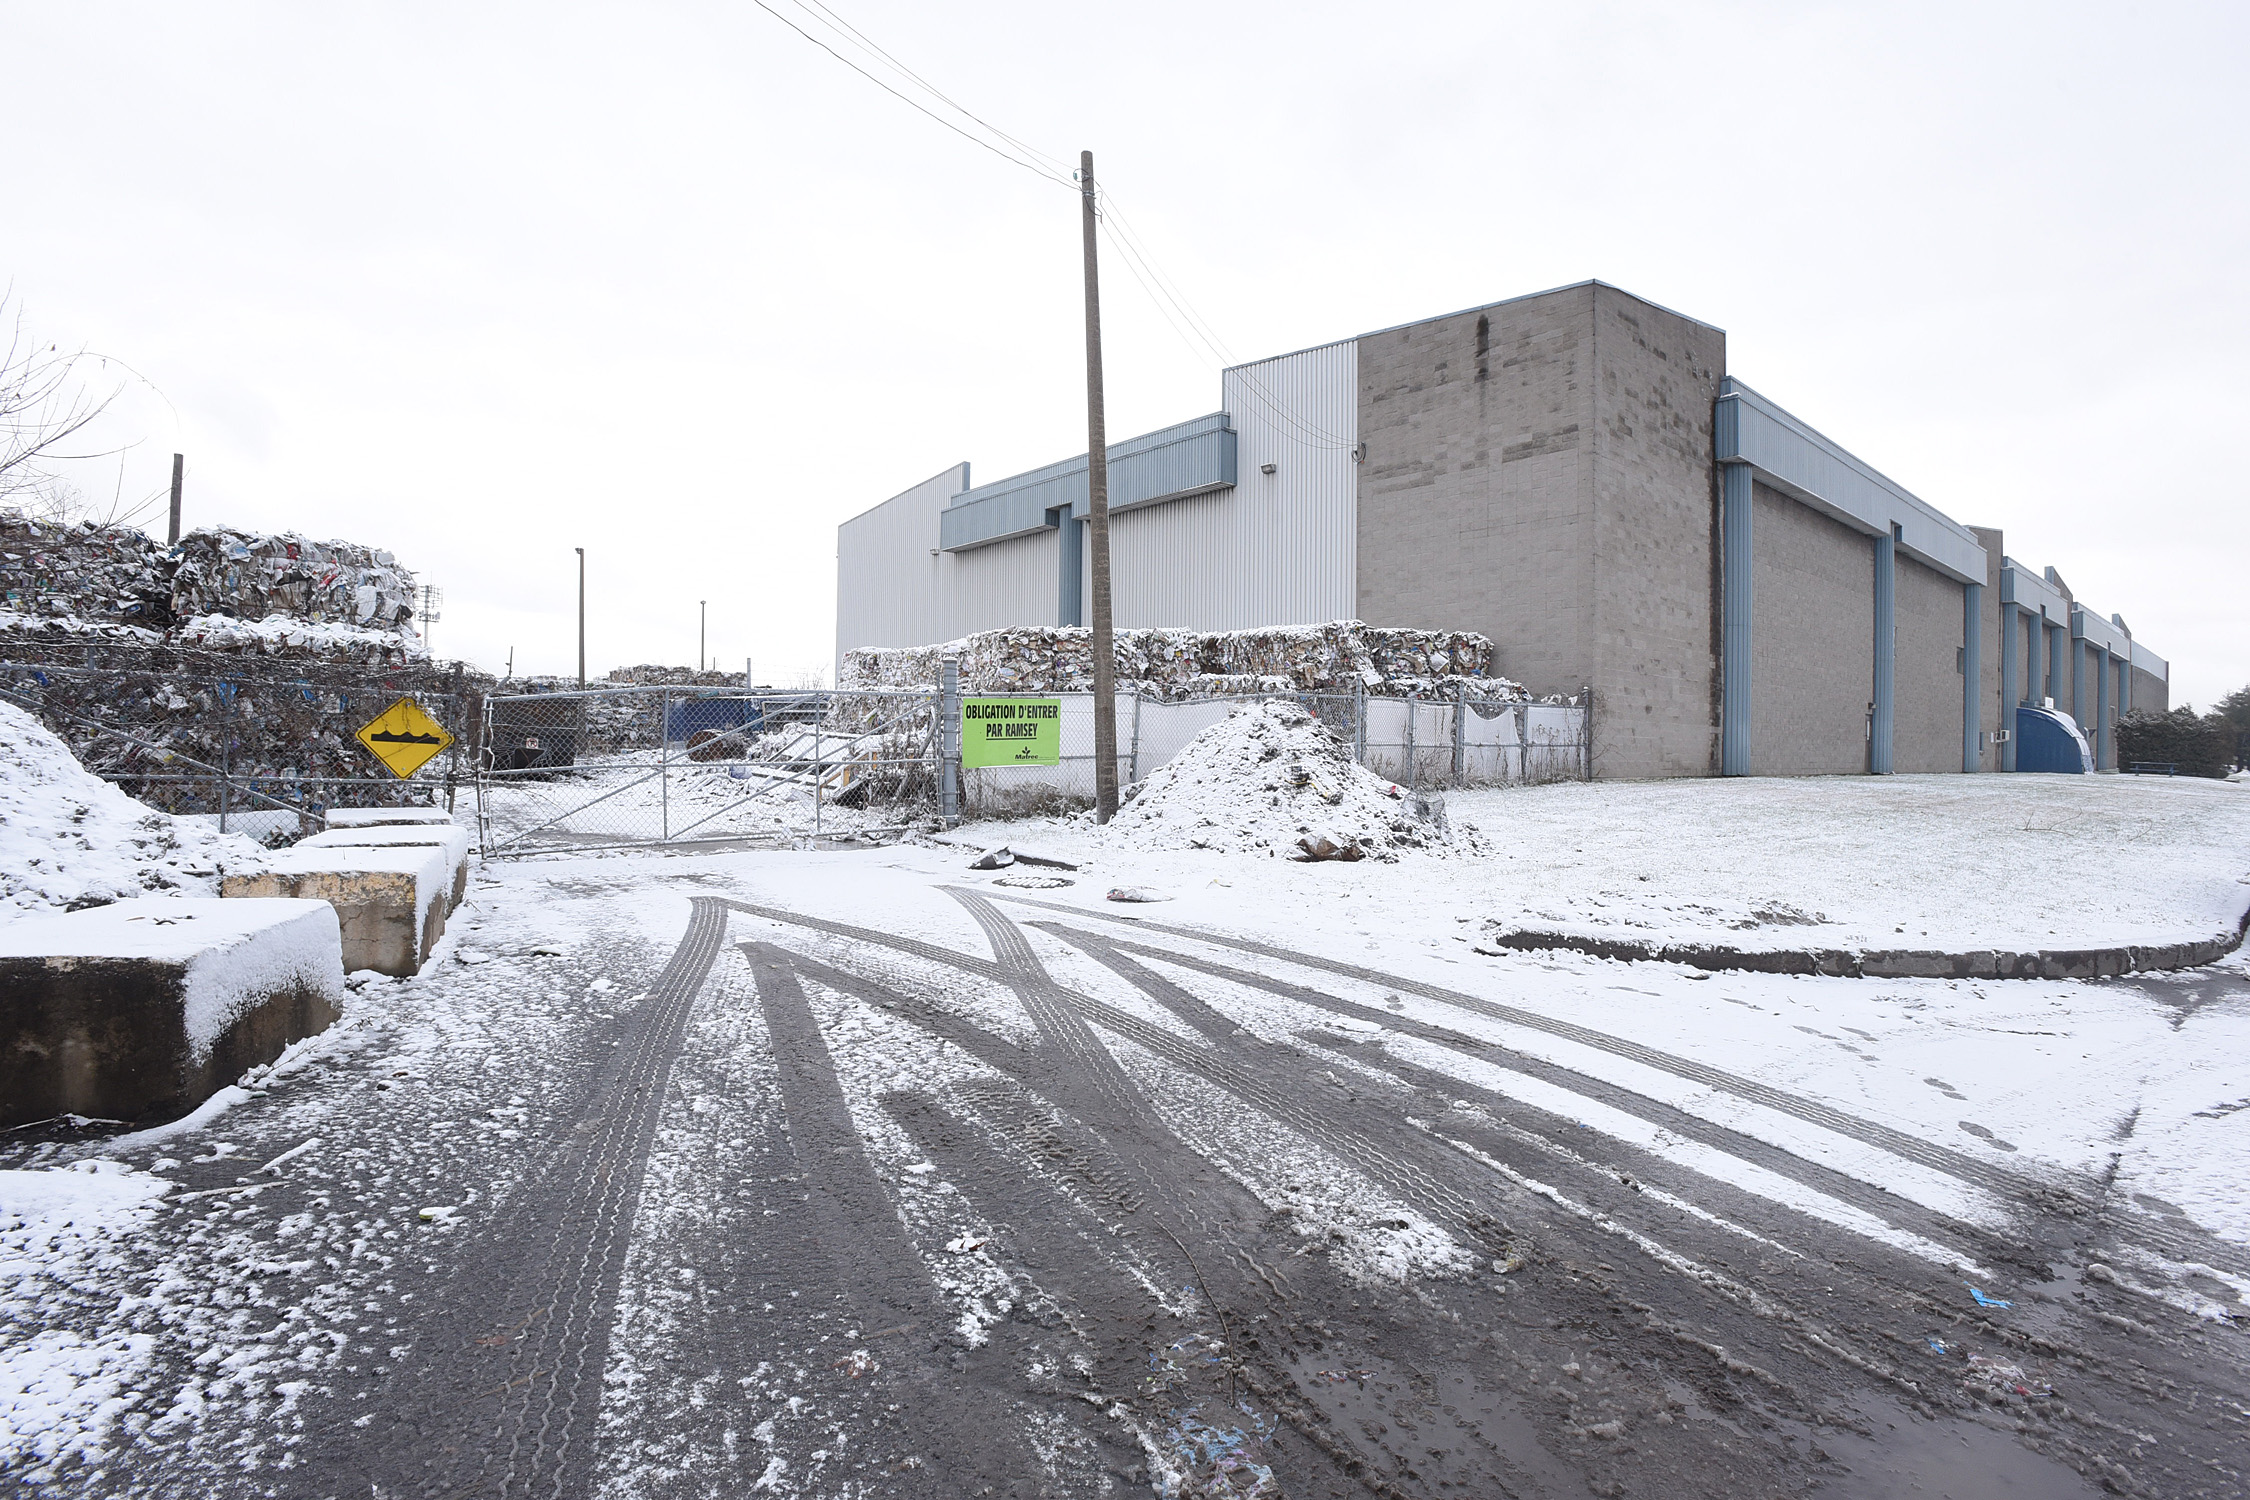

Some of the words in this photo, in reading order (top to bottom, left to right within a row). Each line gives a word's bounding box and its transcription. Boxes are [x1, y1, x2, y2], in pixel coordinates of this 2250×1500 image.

[966, 704, 1016, 719] OBLIGATION
[1018, 705, 1058, 719] D'ENTRER
[986, 723, 1003, 737] PAR
[1005, 723, 1038, 737] RAMSEY
